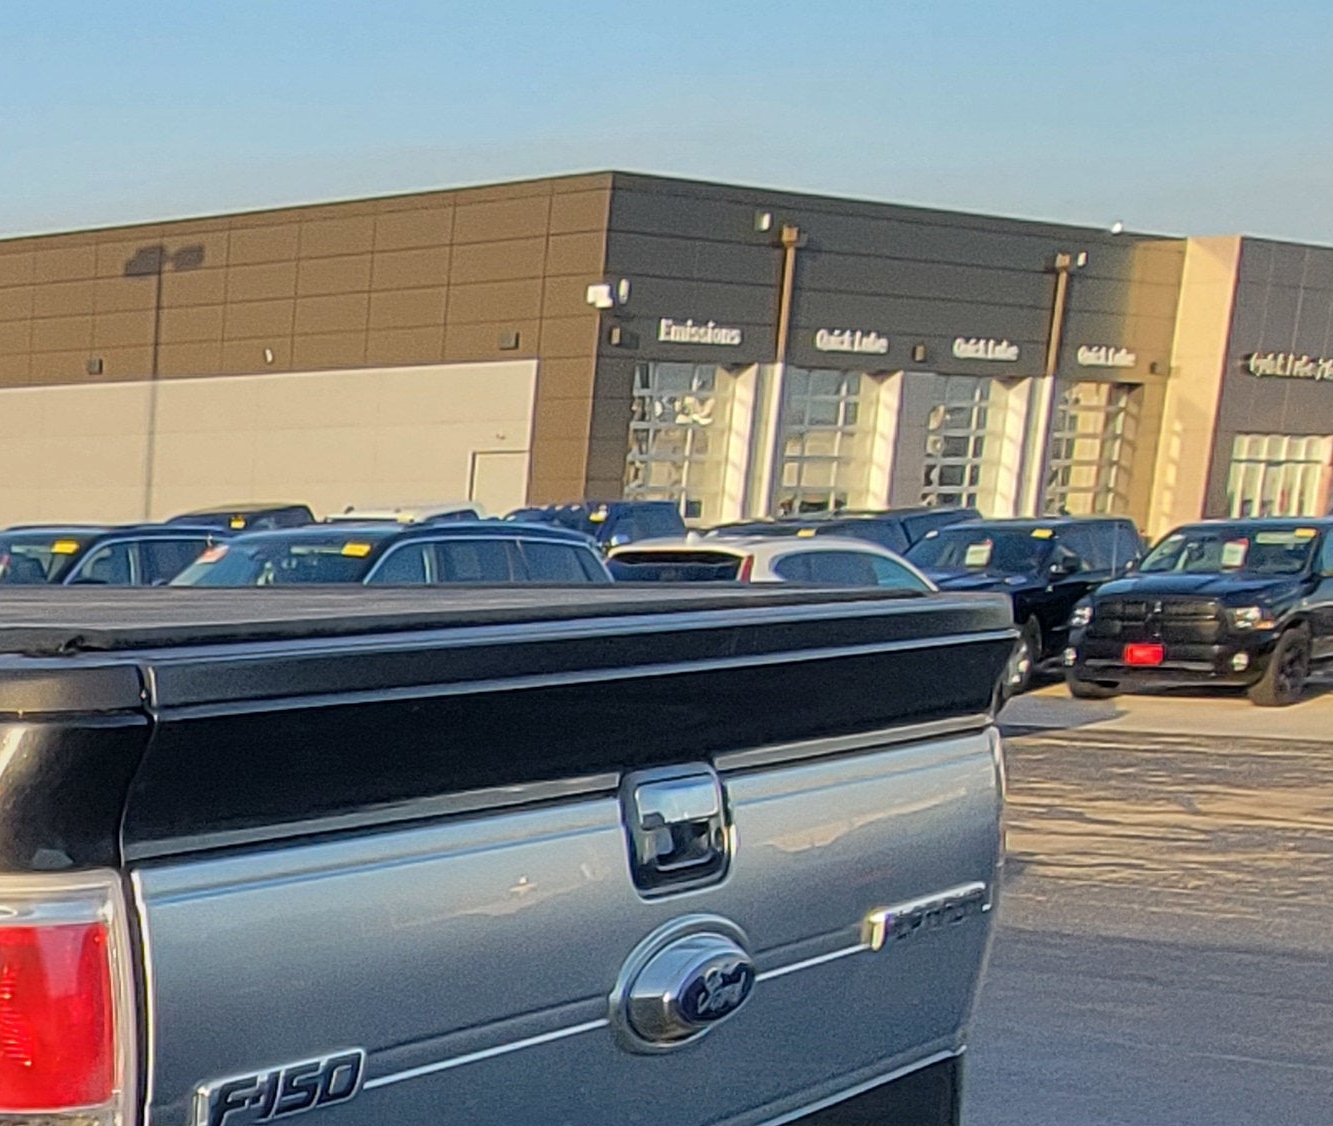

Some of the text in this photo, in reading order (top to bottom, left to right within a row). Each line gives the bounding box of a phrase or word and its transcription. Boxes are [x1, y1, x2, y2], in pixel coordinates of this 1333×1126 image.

[658, 317, 743, 346] Emissions
[815, 328, 852, 352] Quick
[952, 336, 986, 360] Quick
[1077, 345, 1106, 366] Quick
